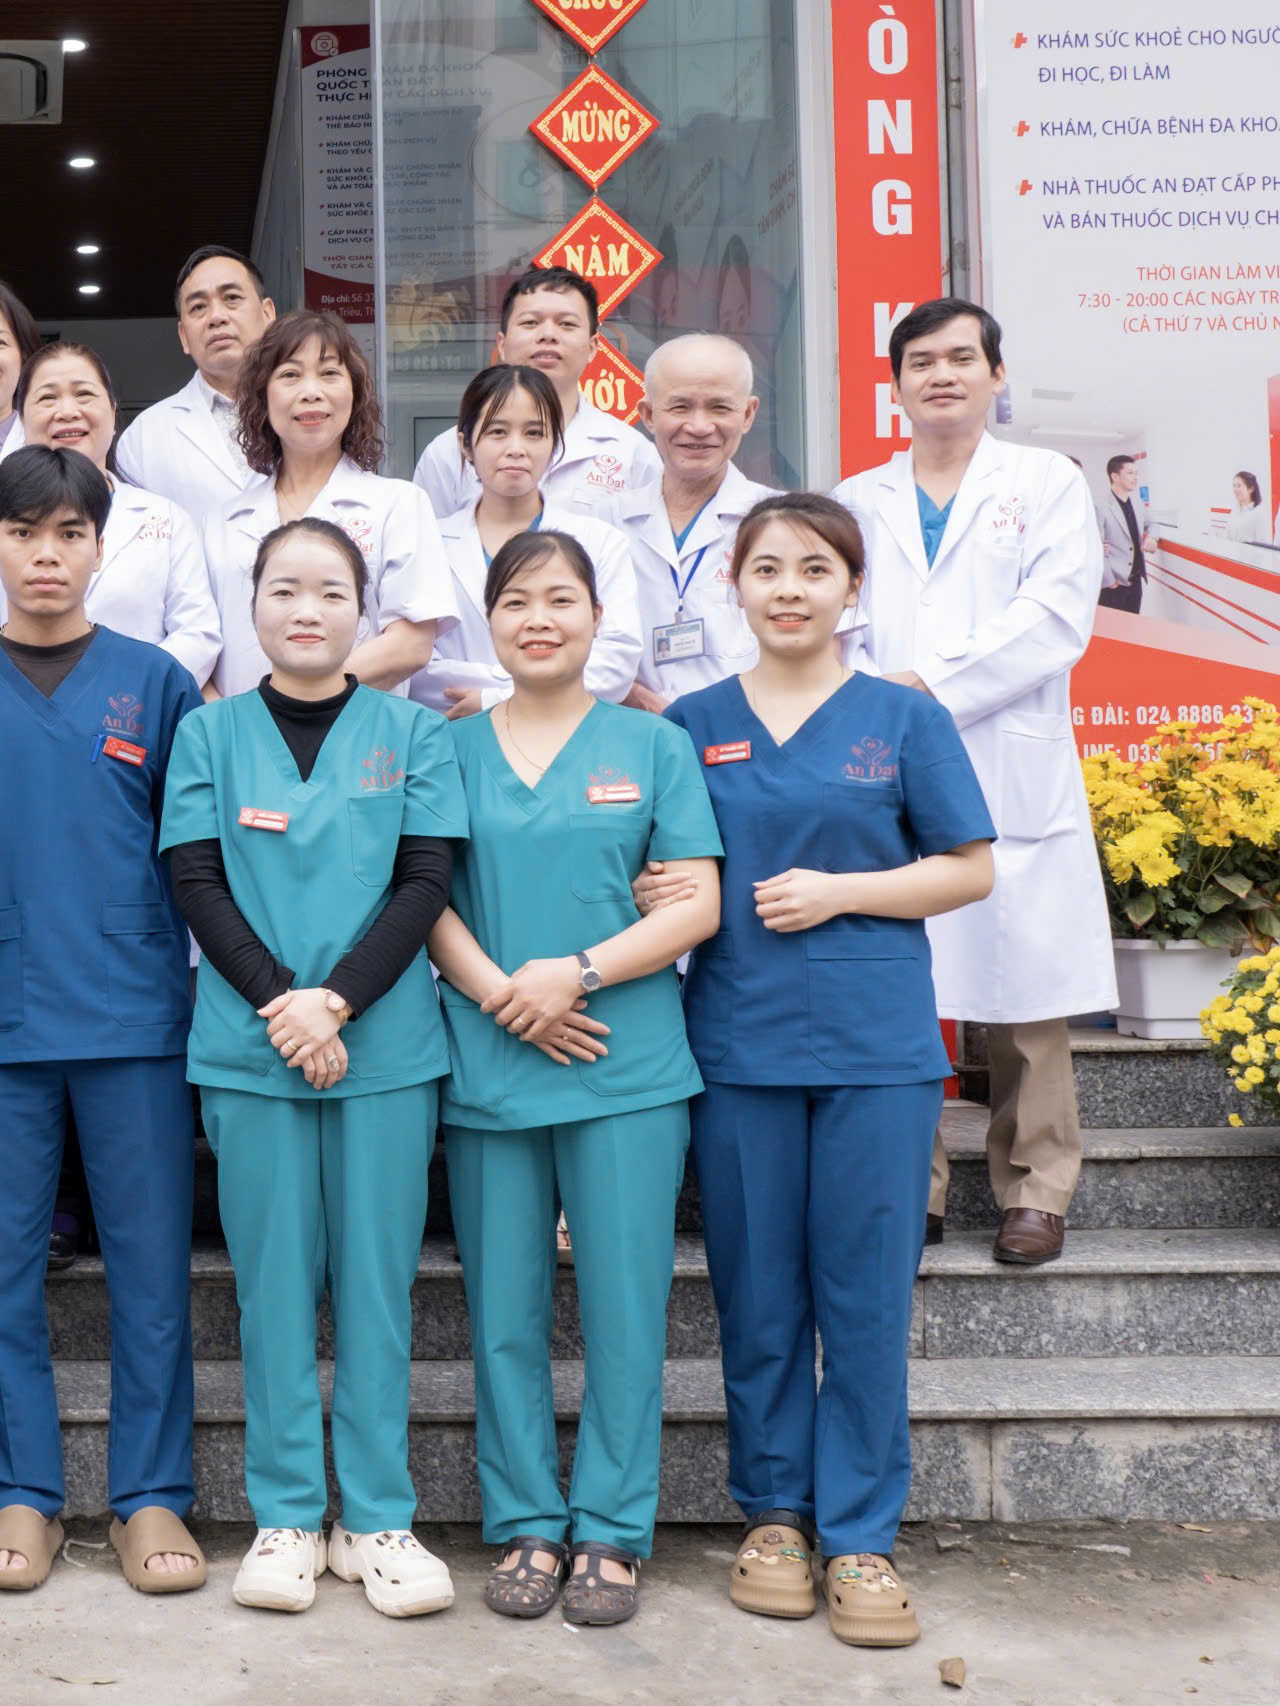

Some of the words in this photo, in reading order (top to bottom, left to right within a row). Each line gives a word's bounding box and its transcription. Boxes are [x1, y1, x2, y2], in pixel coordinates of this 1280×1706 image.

[1037, 30, 1089, 48] KHÁM
[1095, 29, 1130, 47] SỨC
[1135, 26, 1183, 47] KHOẺ
[1188, 29, 1226, 46] CHO
[316, 66, 368, 78] PHÒNG
[1038, 66, 1056, 82] ĐI
[1062, 66, 1104, 85] HỌC,
[1109, 65, 1127, 81] ĐI
[1133, 62, 1170, 80] LÀM
[316, 78, 358, 91] QUỐC
[316, 92, 356, 104] THỰC
[326, 113, 350, 121] KHÁM
[352, 112, 372, 120] CHỮ
[561, 100, 631, 143] MỪNG
[1040, 117, 1096, 138] KHÁM,
[1102, 117, 1152, 136] CHỮA
[1157, 115, 1204, 137] BỆNH
[1209, 117, 1235, 133] ĐA
[1240, 116, 1280, 132] KHO
[326, 140, 351, 148] KHÁM
[1043, 176, 1080, 195] NHÀ
[1084, 173, 1147, 194] THUỐC
[1152, 177, 1177, 193] AN
[1182, 177, 1216, 196] ĐẠT
[1221, 171, 1256, 192] CẤP
[1043, 210, 1065, 229] VÀ
[1071, 210, 1106, 228] BÁN
[1110, 208, 1173, 228] THUỐC
[1178, 210, 1221, 230] DỊCH
[1225, 210, 1249, 230] VỤ
[1255, 209, 1280, 226] CH
[564, 234, 630, 277] NĂM
[1135, 264, 1175, 281] THỜI
[1180, 265, 1221, 281] GIAN
[1226, 262, 1261, 280] LÀM
[1077, 293, 1111, 308] 7:30
[1126, 292, 1169, 307] 20:00
[1173, 289, 1207, 306] CÁC
[1211, 288, 1256, 306] NGÀY
[1260, 290, 1280, 305] TR
[1123, 313, 1151, 334] (CẢ
[1154, 314, 1189, 332] THỨ
[1193, 317, 1203, 331] 7
[1206, 314, 1228, 331] VÀ
[1232, 312, 1267, 331] CHỦ
[1091, 701, 1130, 726] ĐÀI:
[1136, 705, 1171, 726] 024
[1177, 704, 1224, 724] 8886
